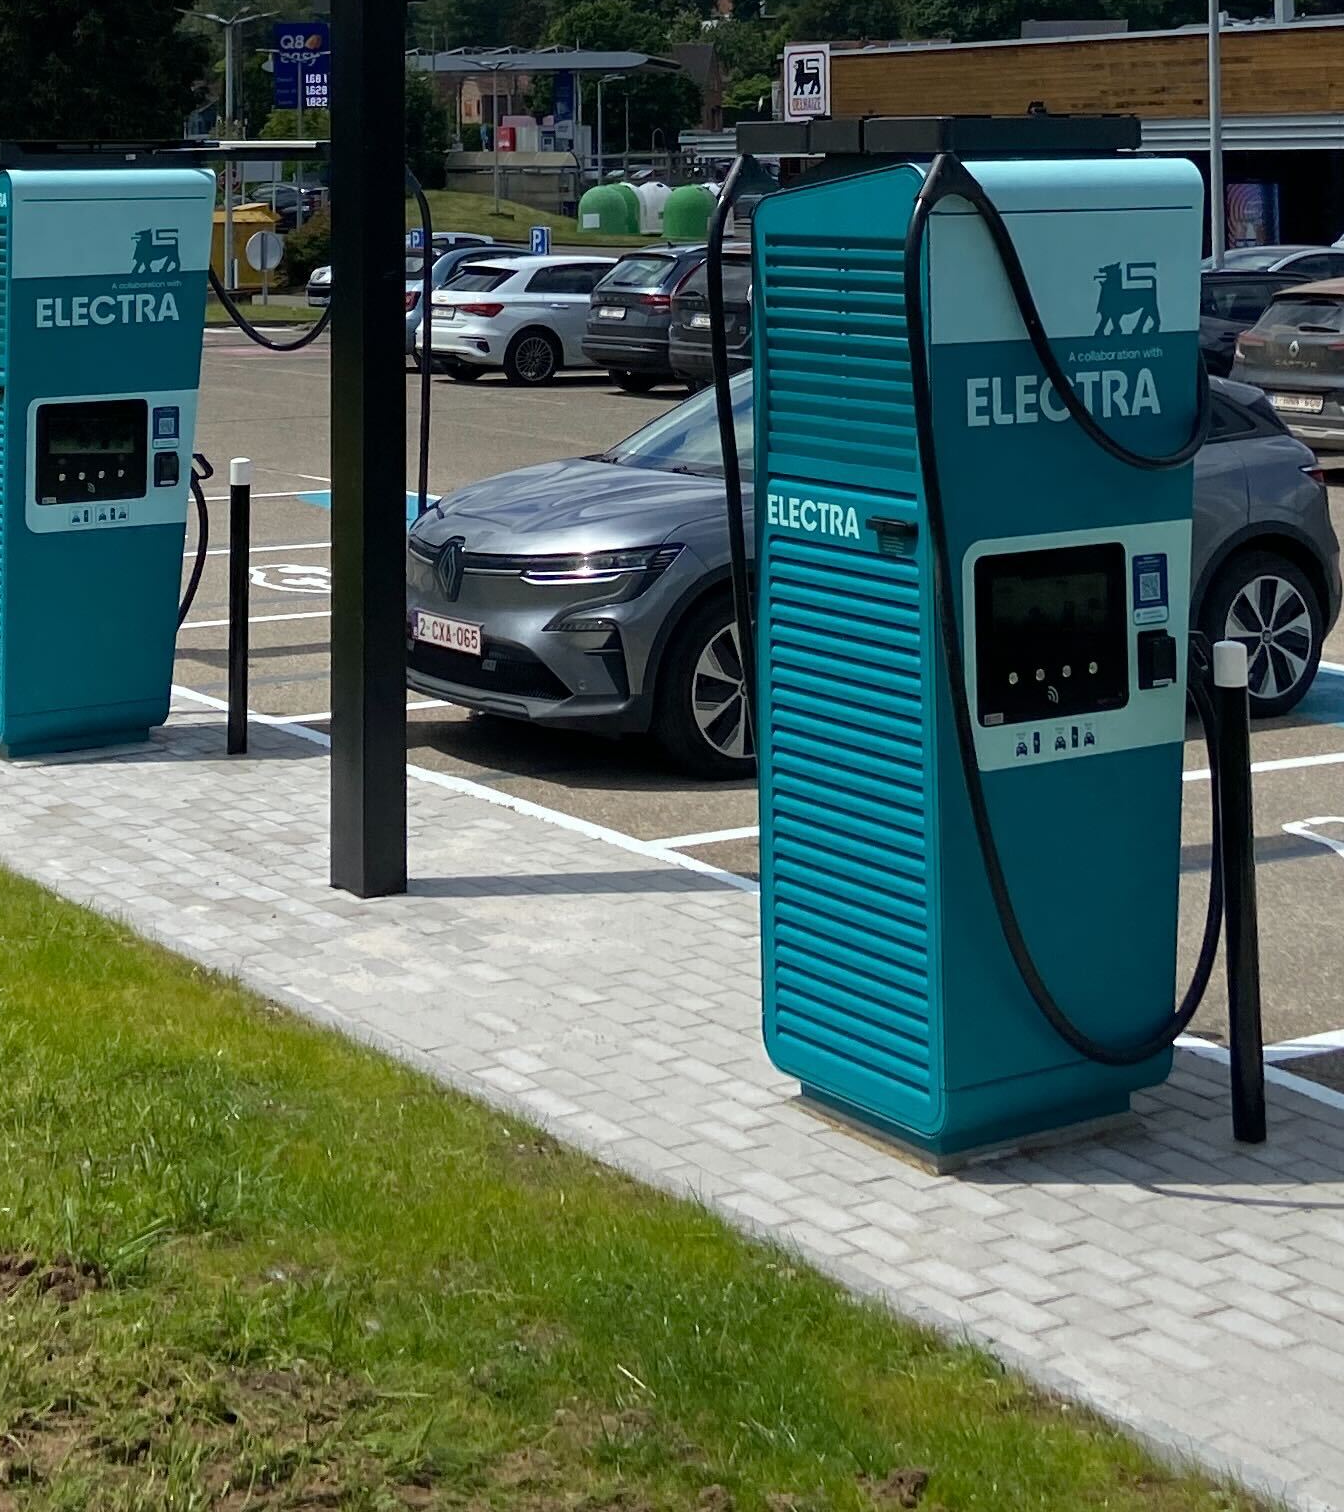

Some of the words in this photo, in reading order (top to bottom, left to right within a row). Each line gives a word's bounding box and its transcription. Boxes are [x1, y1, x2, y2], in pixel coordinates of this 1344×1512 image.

[280, 35, 305, 49] Q8
[533, 230, 541, 251] P
[36, 292, 179, 328] ELECTRA
[1068, 351, 1077, 363] A
[1078, 348, 1141, 363] collaboration
[1143, 347, 1164, 359] with
[967, 367, 1161, 427] ELECTRA
[767, 494, 860, 539] ELECTRA
[419, 617, 478, 649] 2-CXA-065
